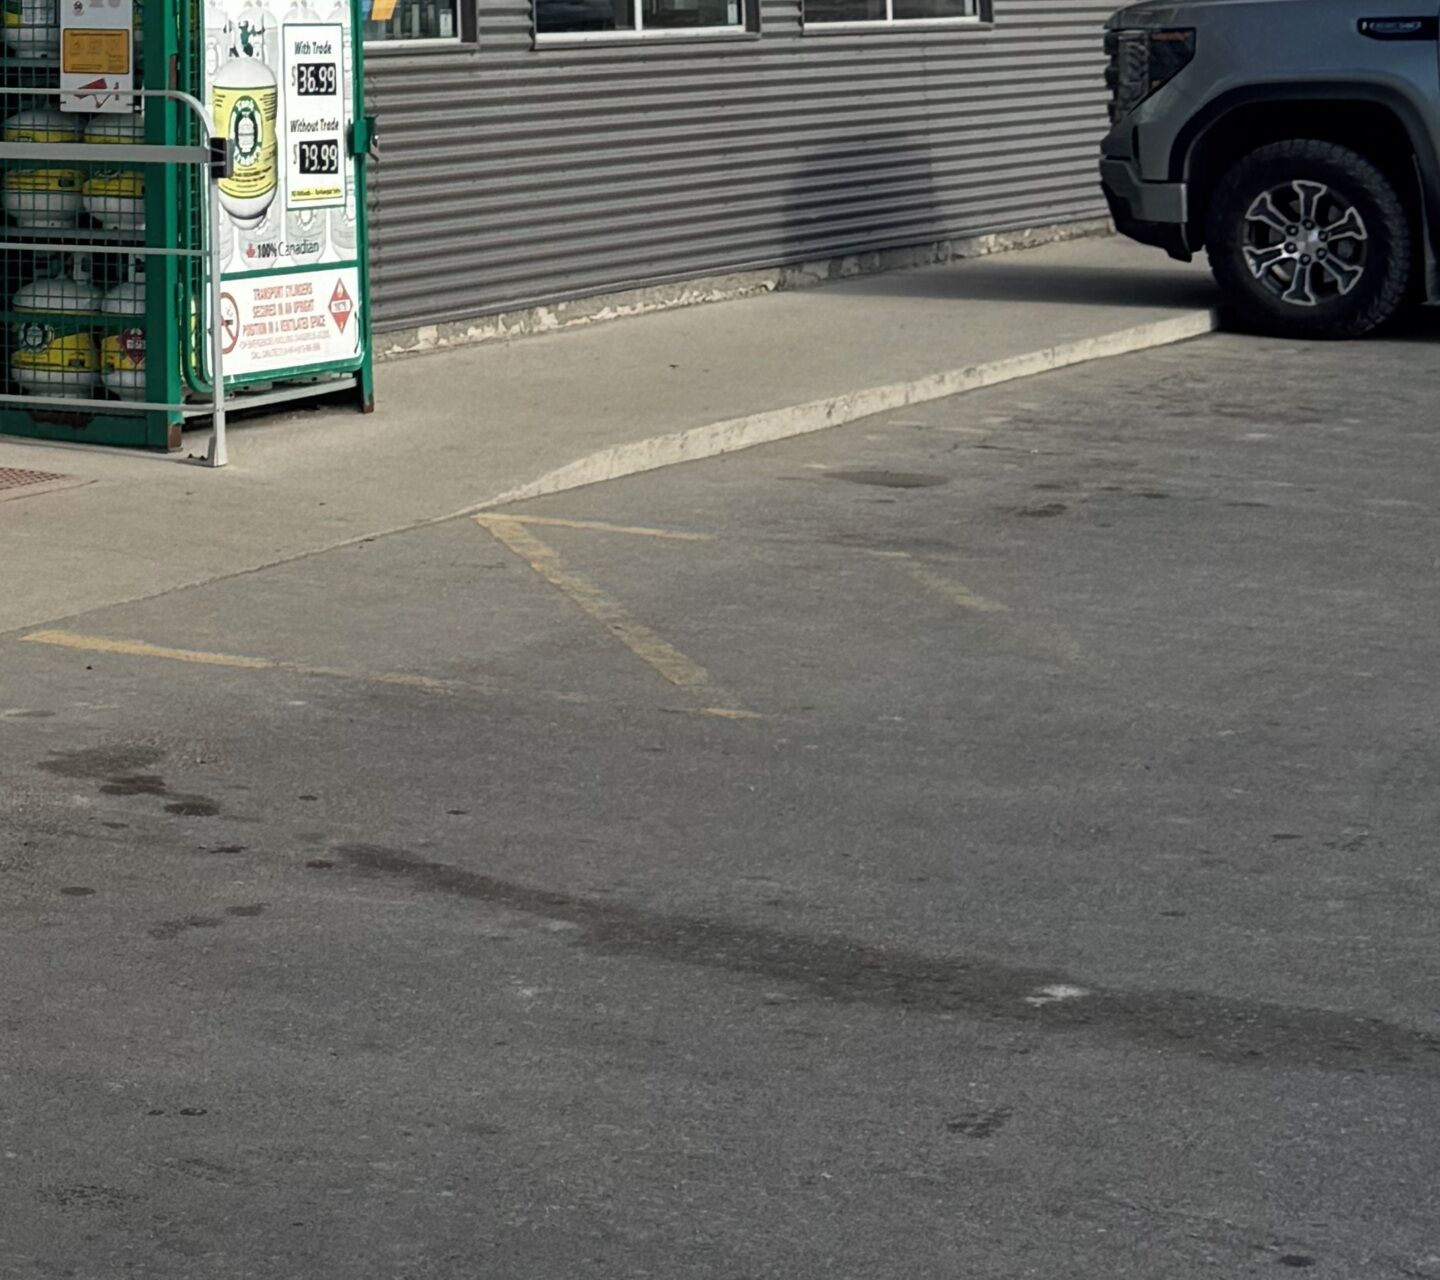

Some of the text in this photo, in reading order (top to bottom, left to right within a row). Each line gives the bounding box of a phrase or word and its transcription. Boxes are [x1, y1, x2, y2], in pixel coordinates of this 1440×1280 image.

[294, 41, 332, 55] With Trade
[290, 118, 339, 133] Without Trade
[257, 239, 319, 258] 100% Canadian
